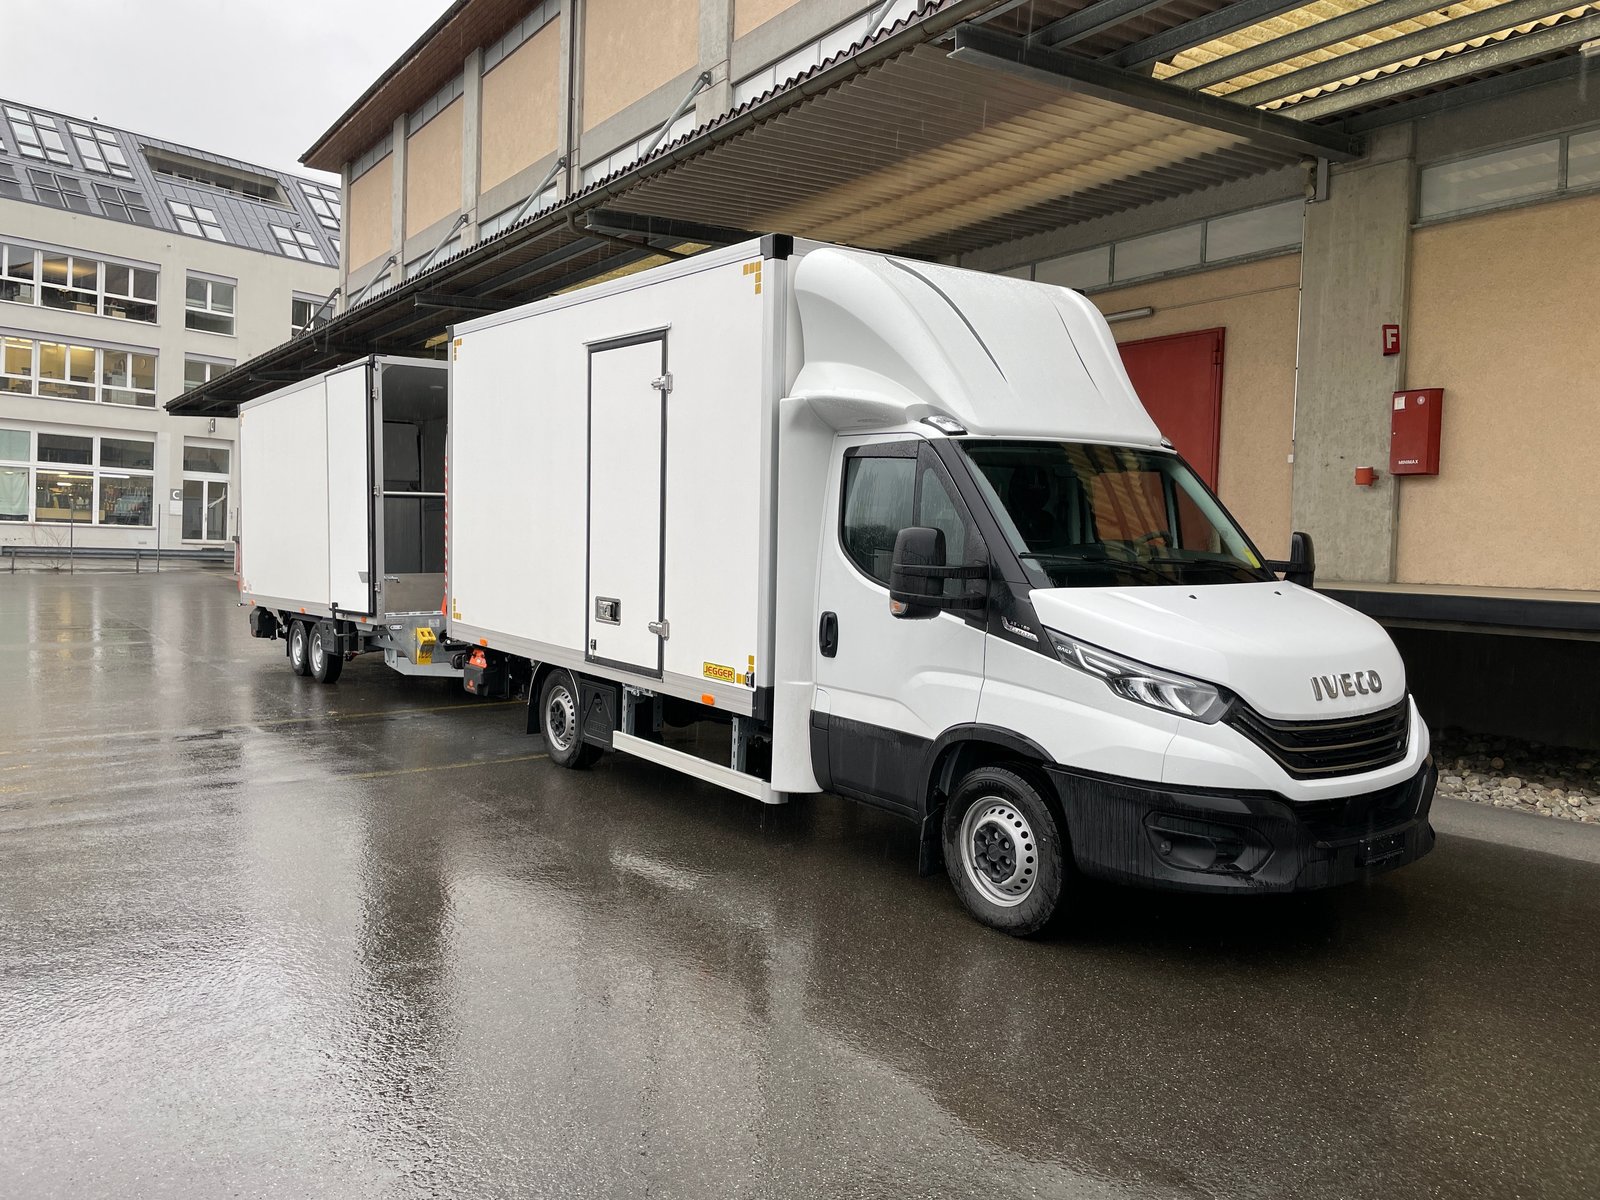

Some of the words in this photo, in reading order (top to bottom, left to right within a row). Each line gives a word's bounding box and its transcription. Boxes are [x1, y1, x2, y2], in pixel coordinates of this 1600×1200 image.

[1386, 328, 1398, 349] F
[172, 490, 180, 499] C
[1057, 645, 1073, 655] DAILY
[704, 665, 733, 678] JEGGER
[1309, 669, 1383, 702] IVECO
